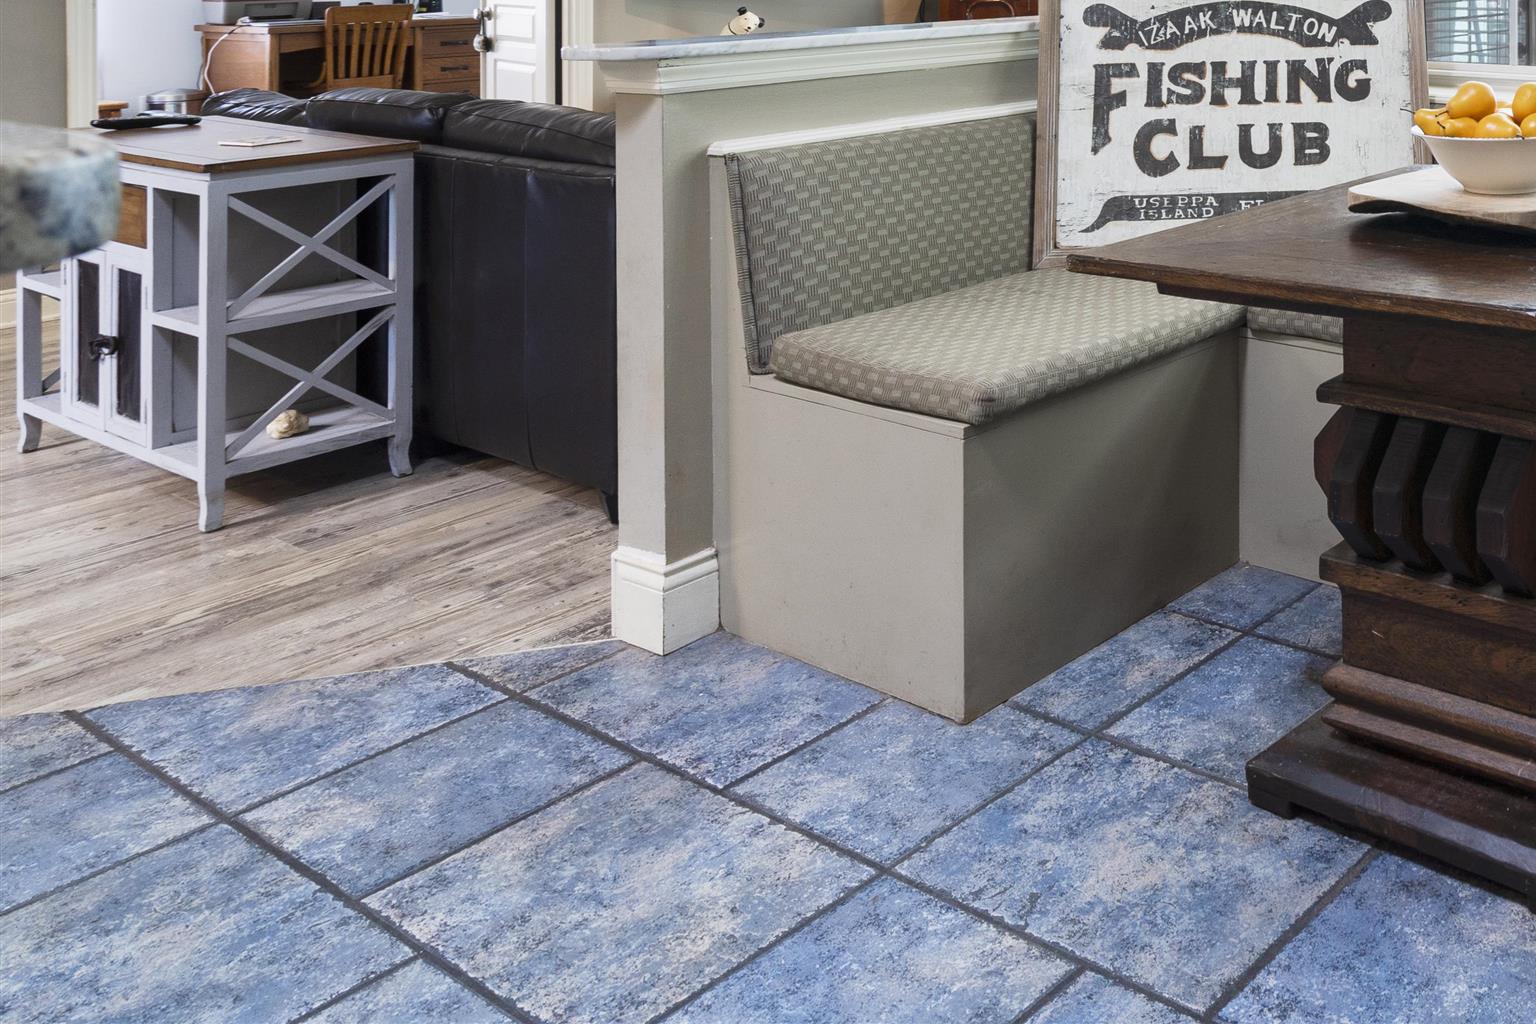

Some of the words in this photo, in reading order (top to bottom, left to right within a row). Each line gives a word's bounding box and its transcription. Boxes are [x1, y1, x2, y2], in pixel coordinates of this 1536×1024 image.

[1138, 10, 1217, 46] IZAAK
[1233, 7, 1337, 43] WALTON
[1091, 57, 1372, 155] FISHING
[1132, 118, 1331, 178] CLUB
[1138, 207, 1215, 220] ISLAND
